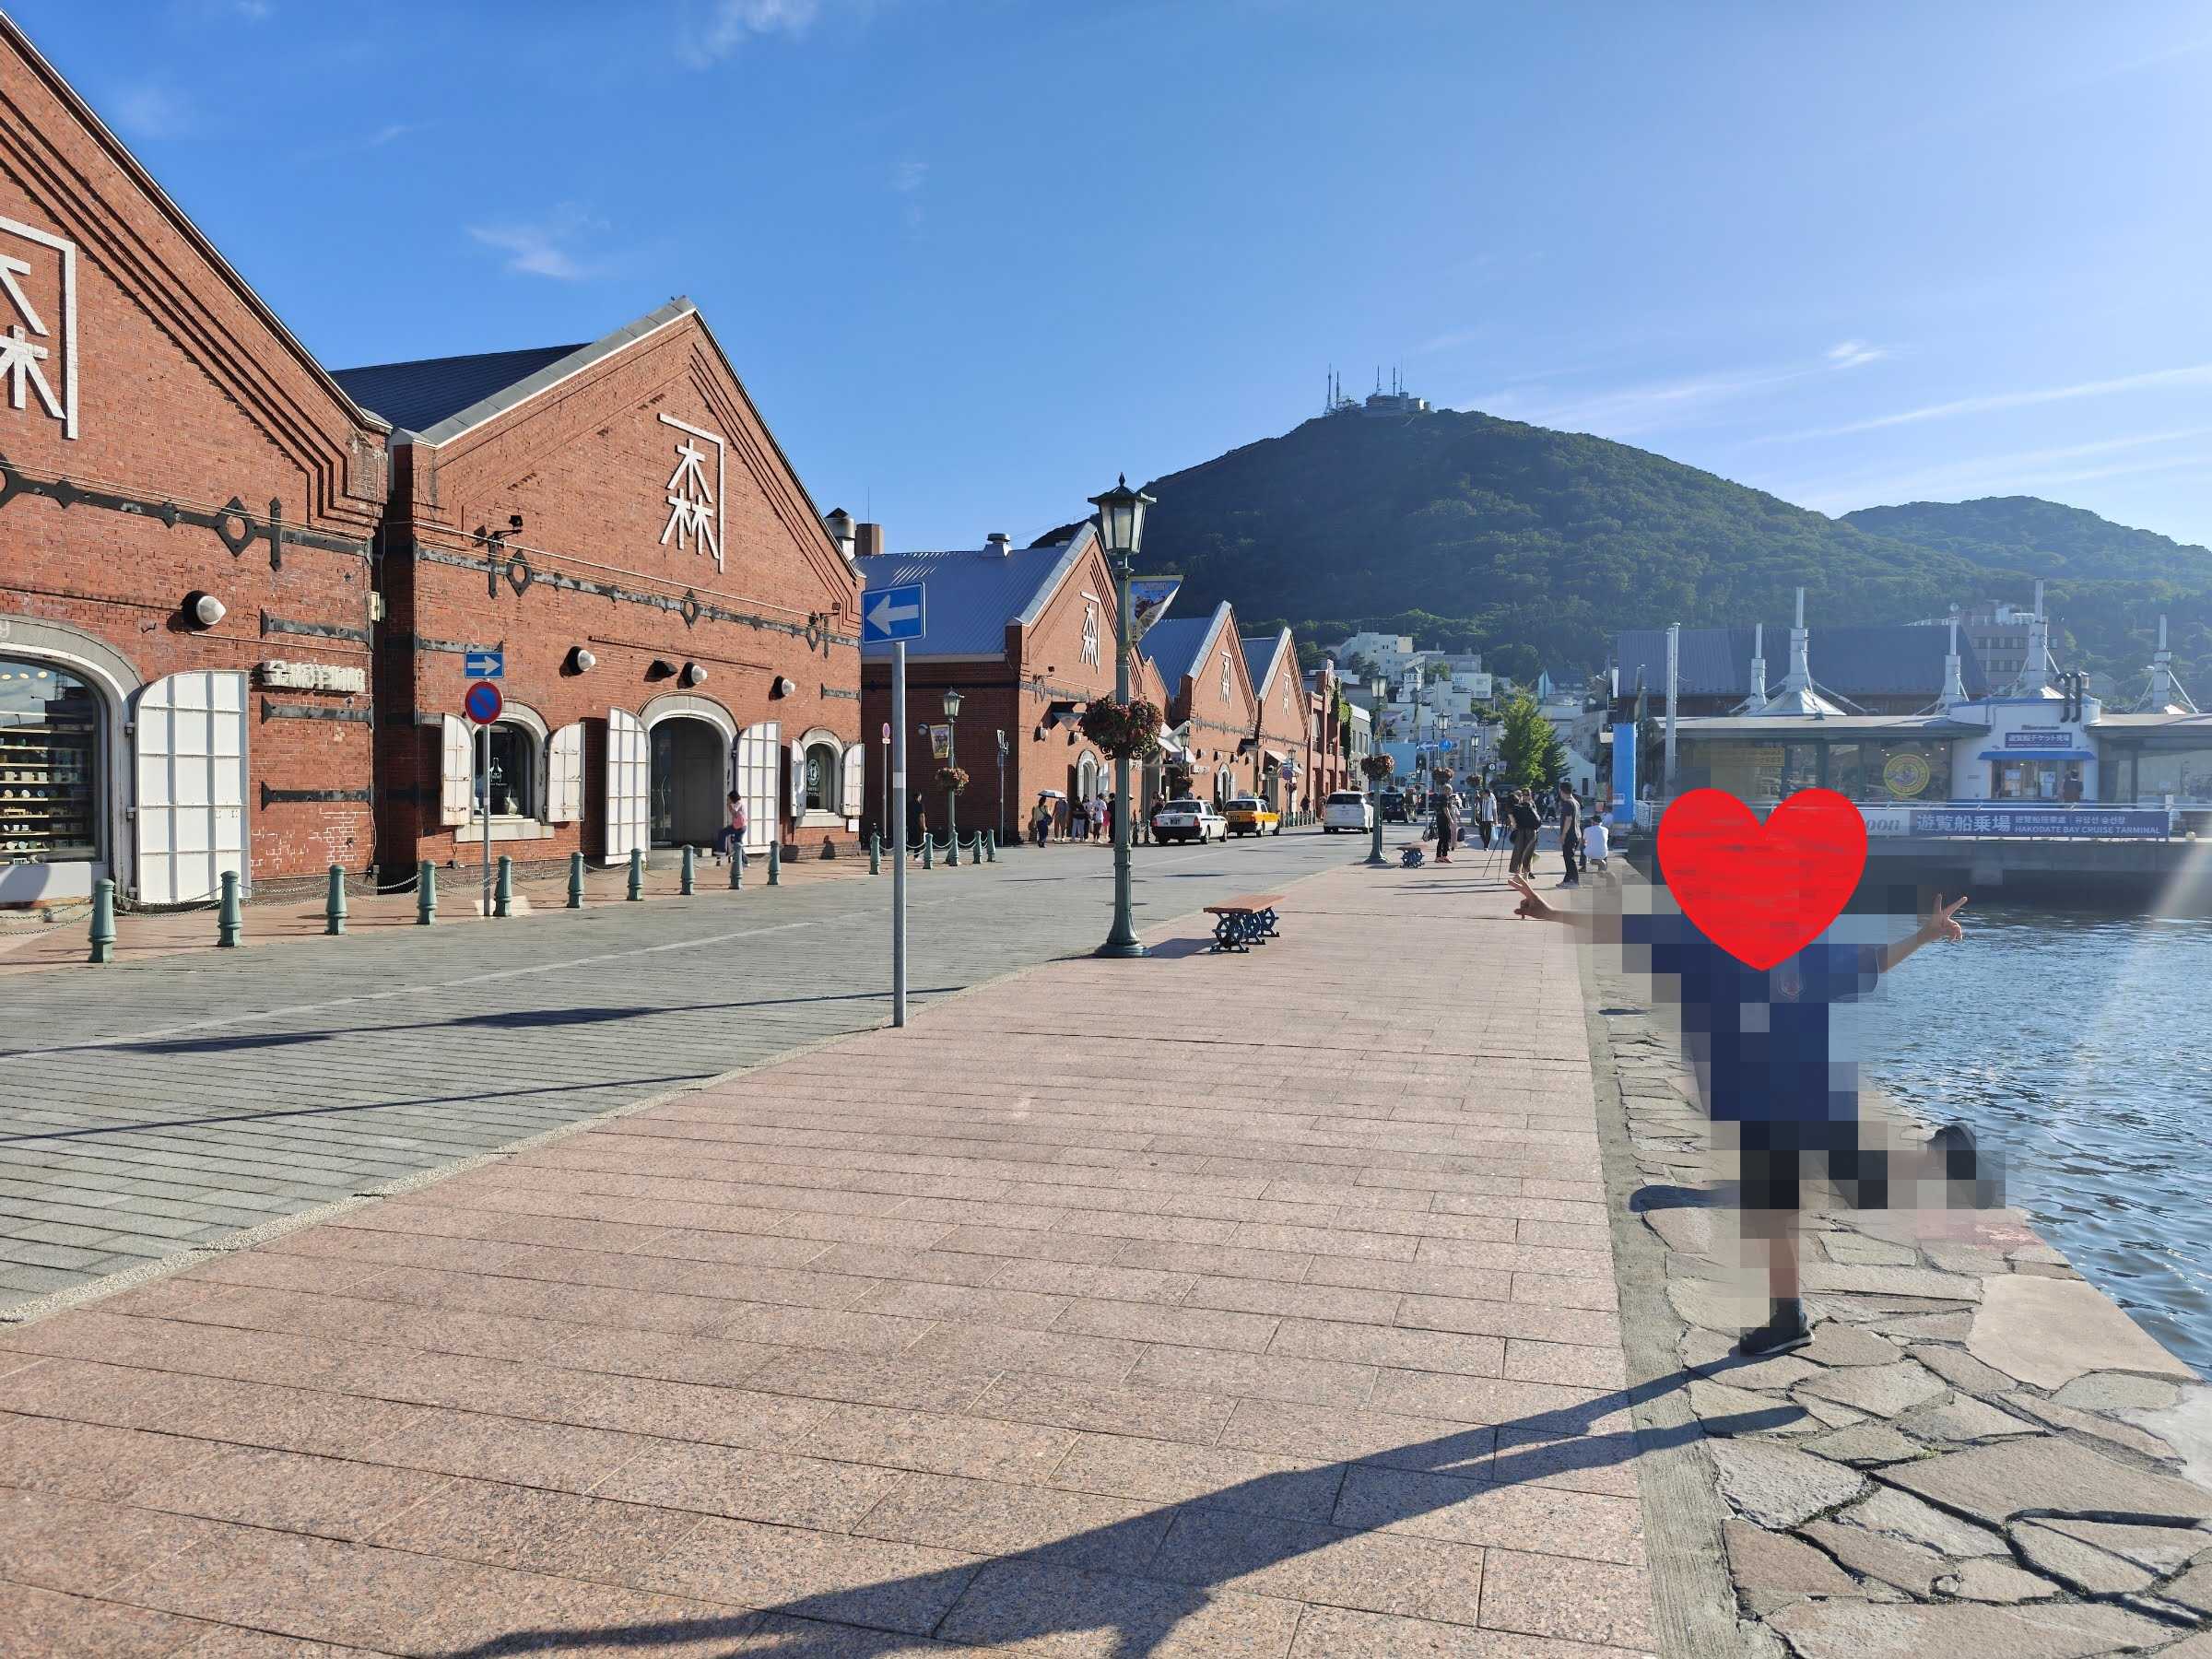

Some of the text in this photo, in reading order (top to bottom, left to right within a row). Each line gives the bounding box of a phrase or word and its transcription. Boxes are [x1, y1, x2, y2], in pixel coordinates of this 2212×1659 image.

[1916, 814, 2011, 832] 遊覧船乗場
[2081, 826, 2113, 834] CRUISE
[2115, 826, 2160, 834] TARMINAL
